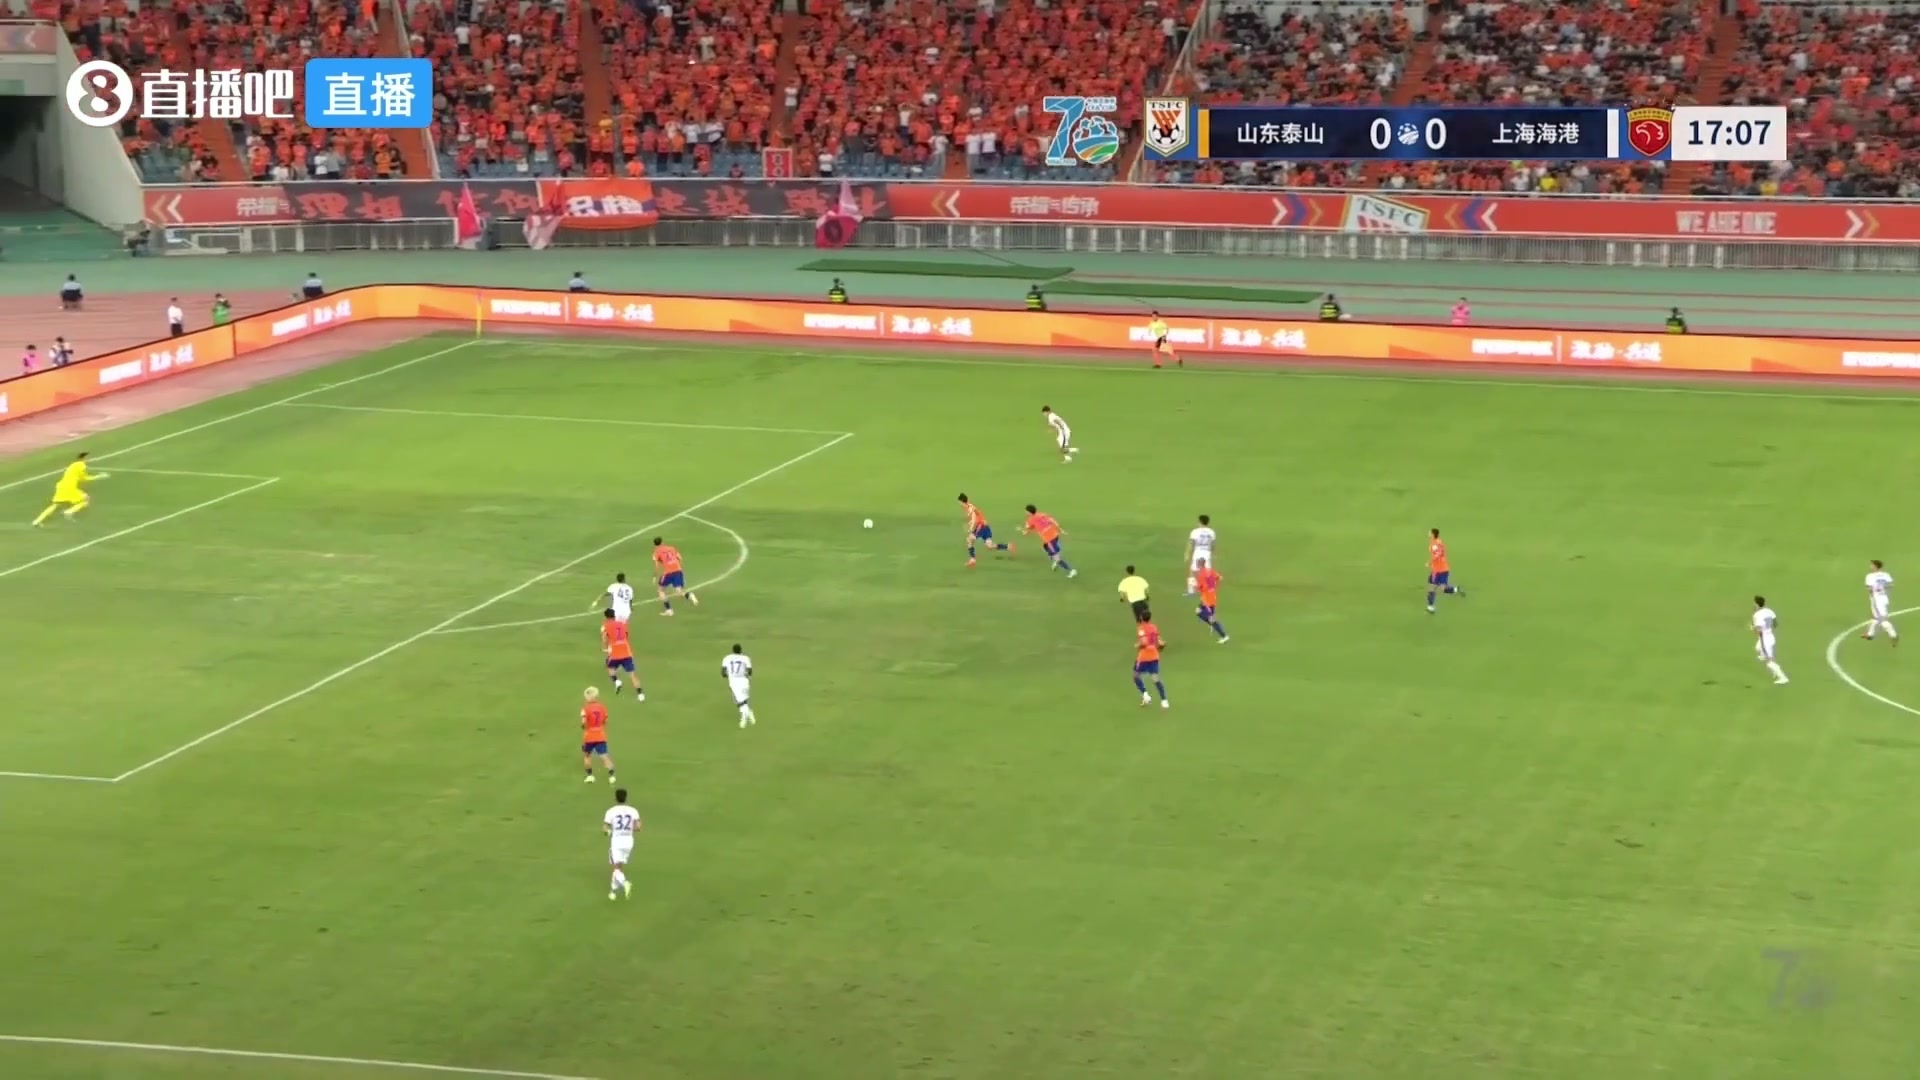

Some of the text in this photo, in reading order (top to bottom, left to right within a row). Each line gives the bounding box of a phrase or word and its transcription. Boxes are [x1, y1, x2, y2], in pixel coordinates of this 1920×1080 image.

[1356, 197, 1418, 227] TSFC
[1675, 210, 1705, 233] WE
[730, 660, 742, 674] 17
[614, 814, 633, 831] 32
